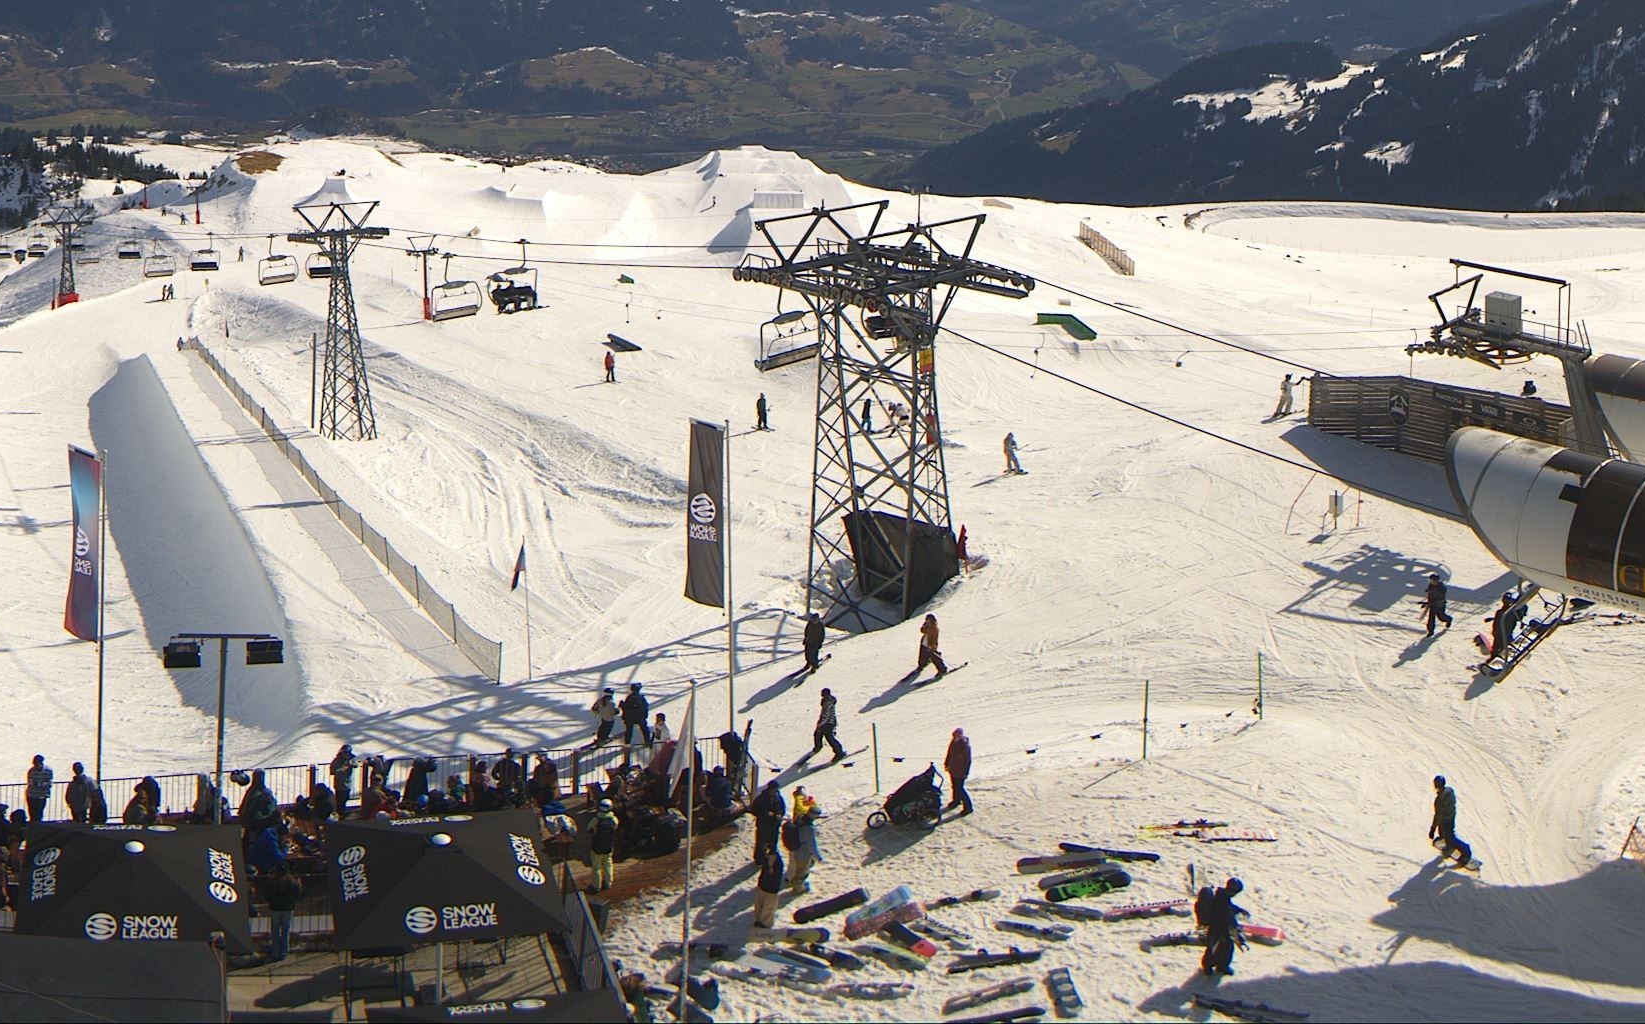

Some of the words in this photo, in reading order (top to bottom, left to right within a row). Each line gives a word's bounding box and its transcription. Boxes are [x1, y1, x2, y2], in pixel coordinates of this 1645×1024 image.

[1572, 585, 1640, 607] CRUISING
[208, 847, 225, 880] SNOW
[508, 833, 530, 865] SNOW
[42, 864, 57, 897] SNOW
[220, 851, 235, 884] LEAGUE
[353, 863, 370, 896] SNOW
[31, 867, 44, 901] LEAGUE
[340, 867, 357, 902] LEAGUE
[122, 915, 179, 927] SNOW
[441, 902, 496, 919] SNOW
[443, 914, 499, 930] LEAGUE
[122, 927, 179, 939] LEAGUE
